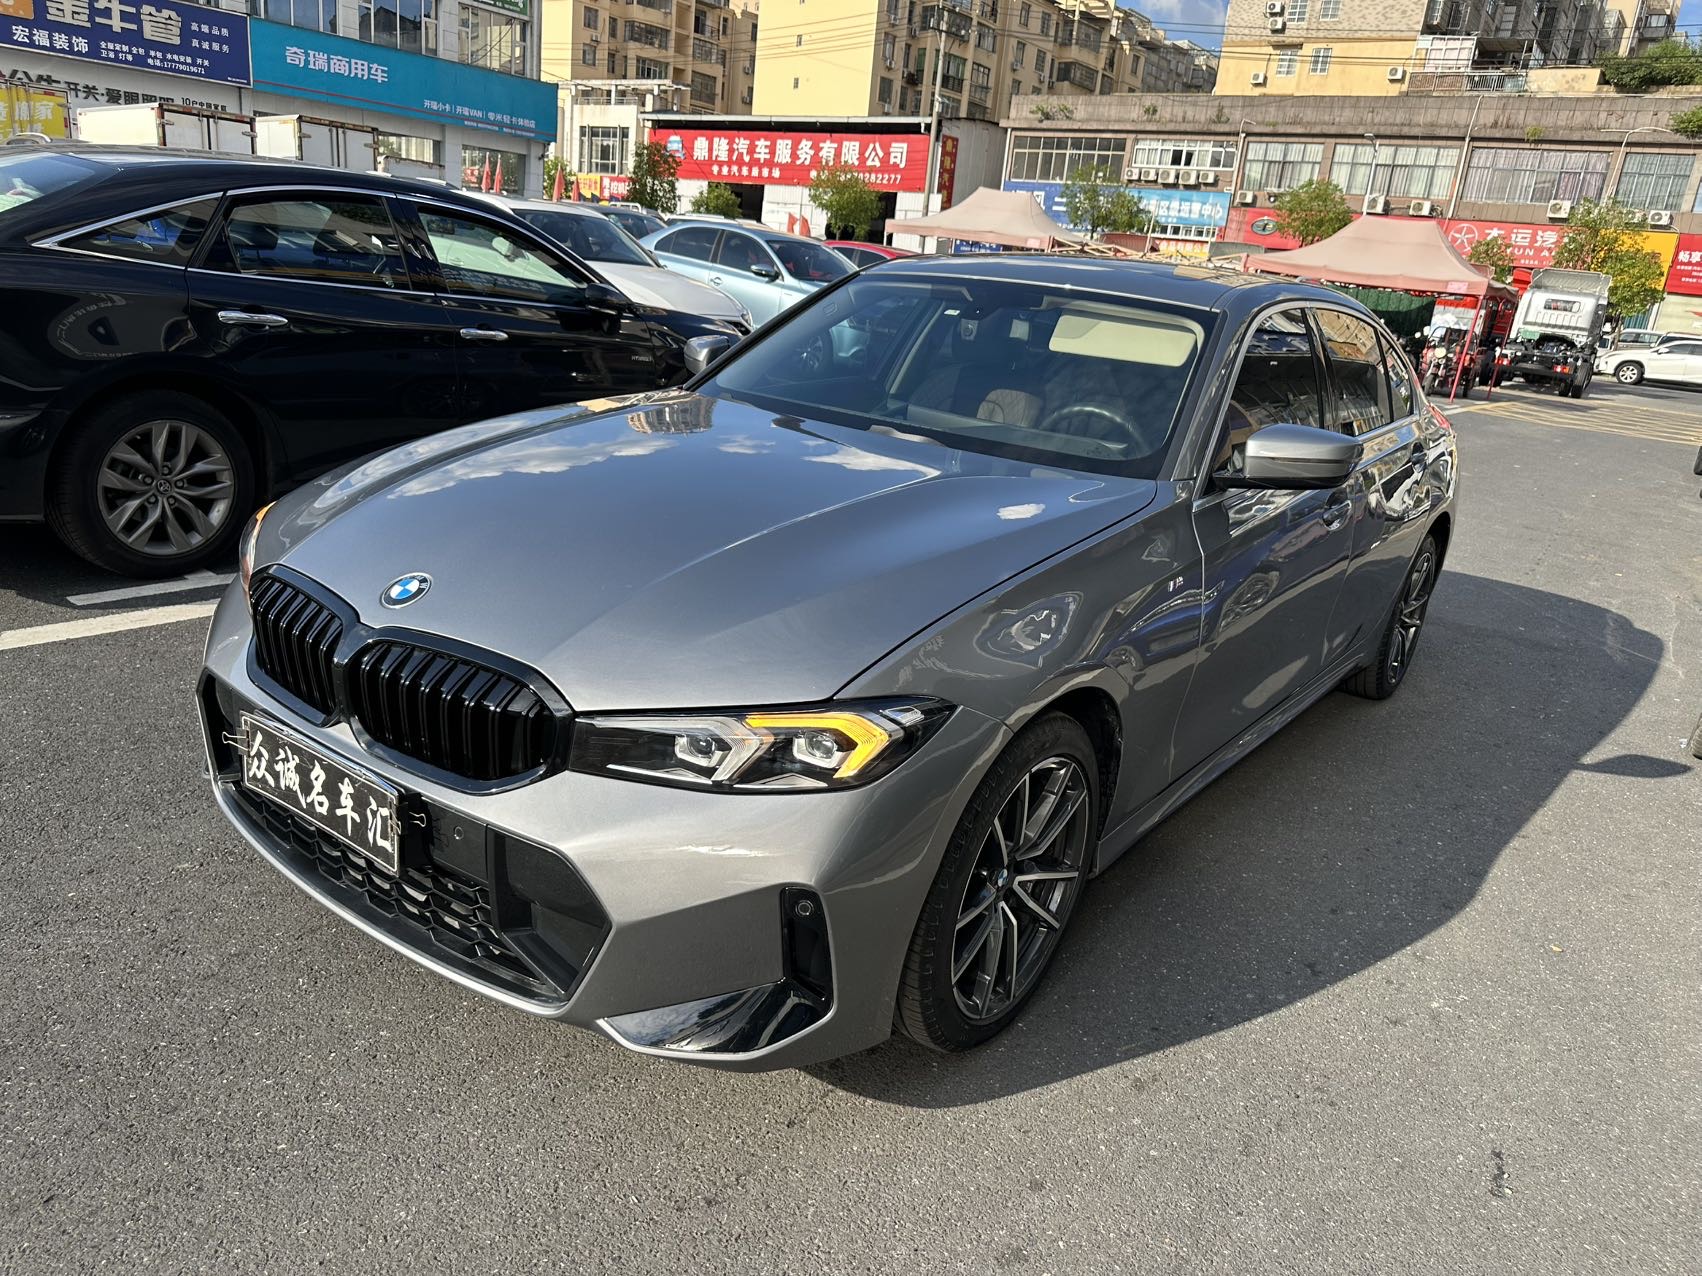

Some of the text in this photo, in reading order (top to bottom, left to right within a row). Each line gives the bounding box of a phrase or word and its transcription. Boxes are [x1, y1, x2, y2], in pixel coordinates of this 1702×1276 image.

[12, 25, 88, 53] 宏福装饰
[46, 0, 181, 45] 金牛管
[191, 22, 229, 37] 高端品质
[192, 39, 230, 54] 真诚服务
[285, 46, 389, 83] 奇瑞商用车
[692, 136, 909, 169] 鼎隆汽车服务有限公司
[250, 731, 393, 853] 众诚名车汇
